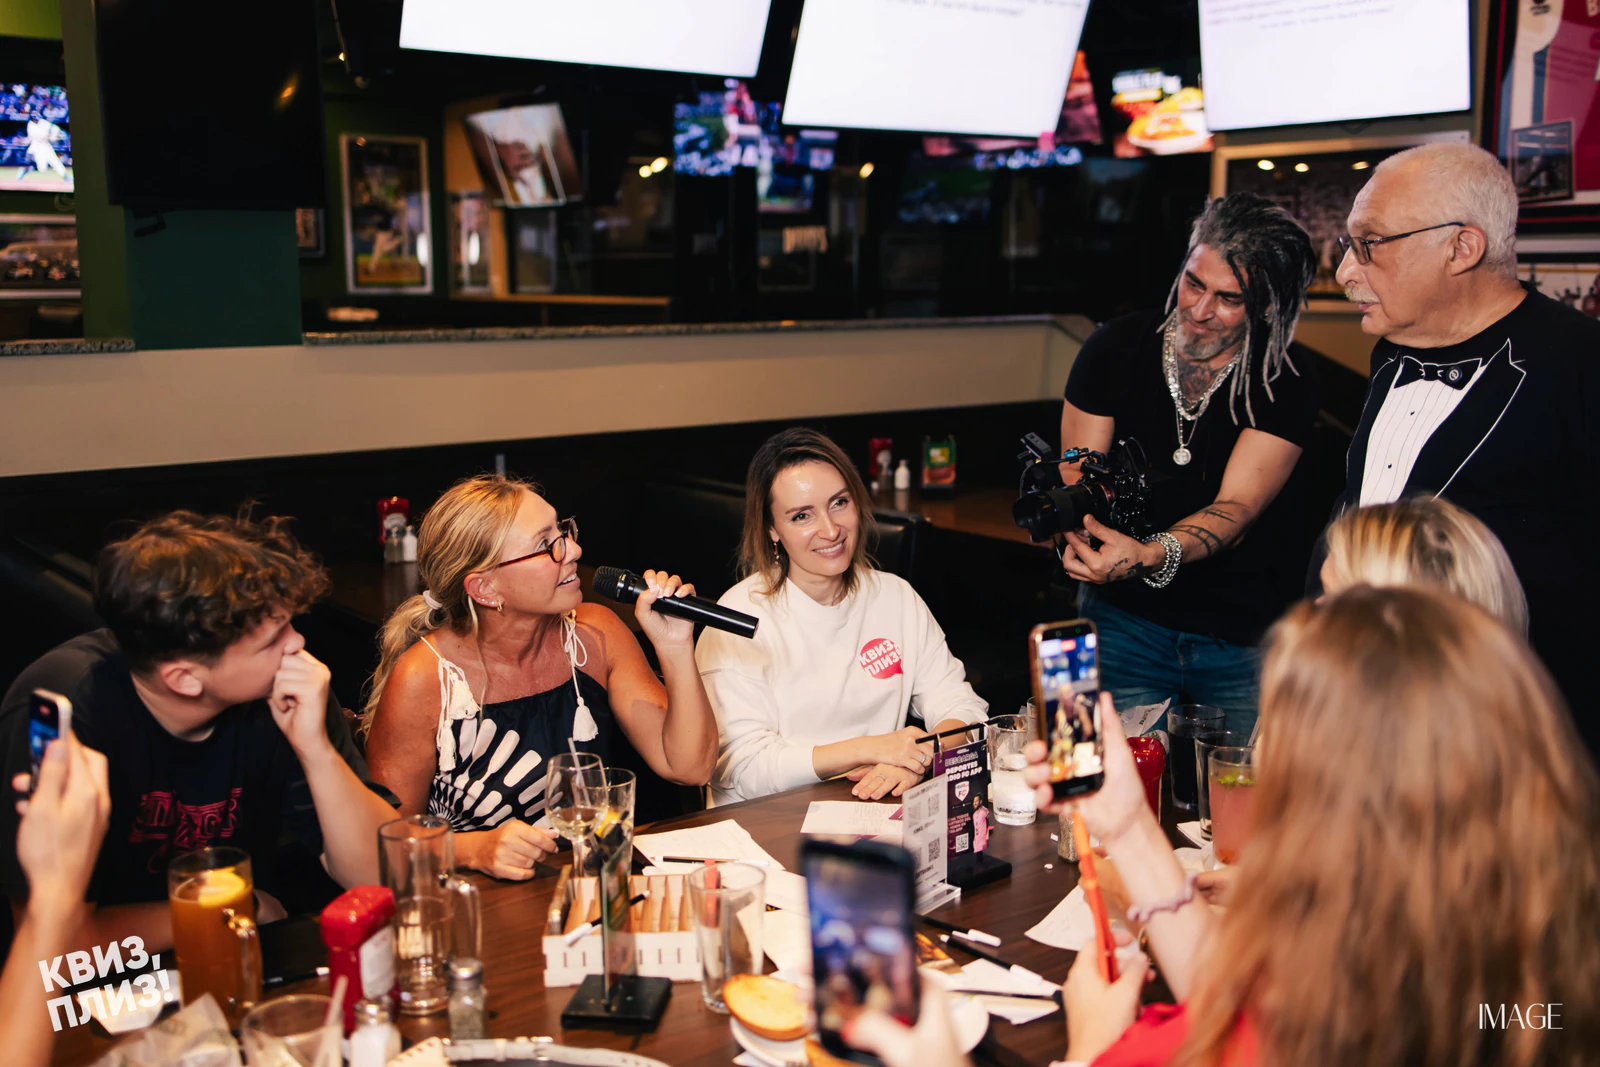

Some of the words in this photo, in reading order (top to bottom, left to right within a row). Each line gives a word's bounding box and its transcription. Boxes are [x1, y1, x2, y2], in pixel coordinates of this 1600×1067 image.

[945, 751, 979, 767] DESCARGA
[945, 760, 978, 774] DEPORTES
[970, 766, 983, 776] APP
[958, 789, 967, 797] FC
